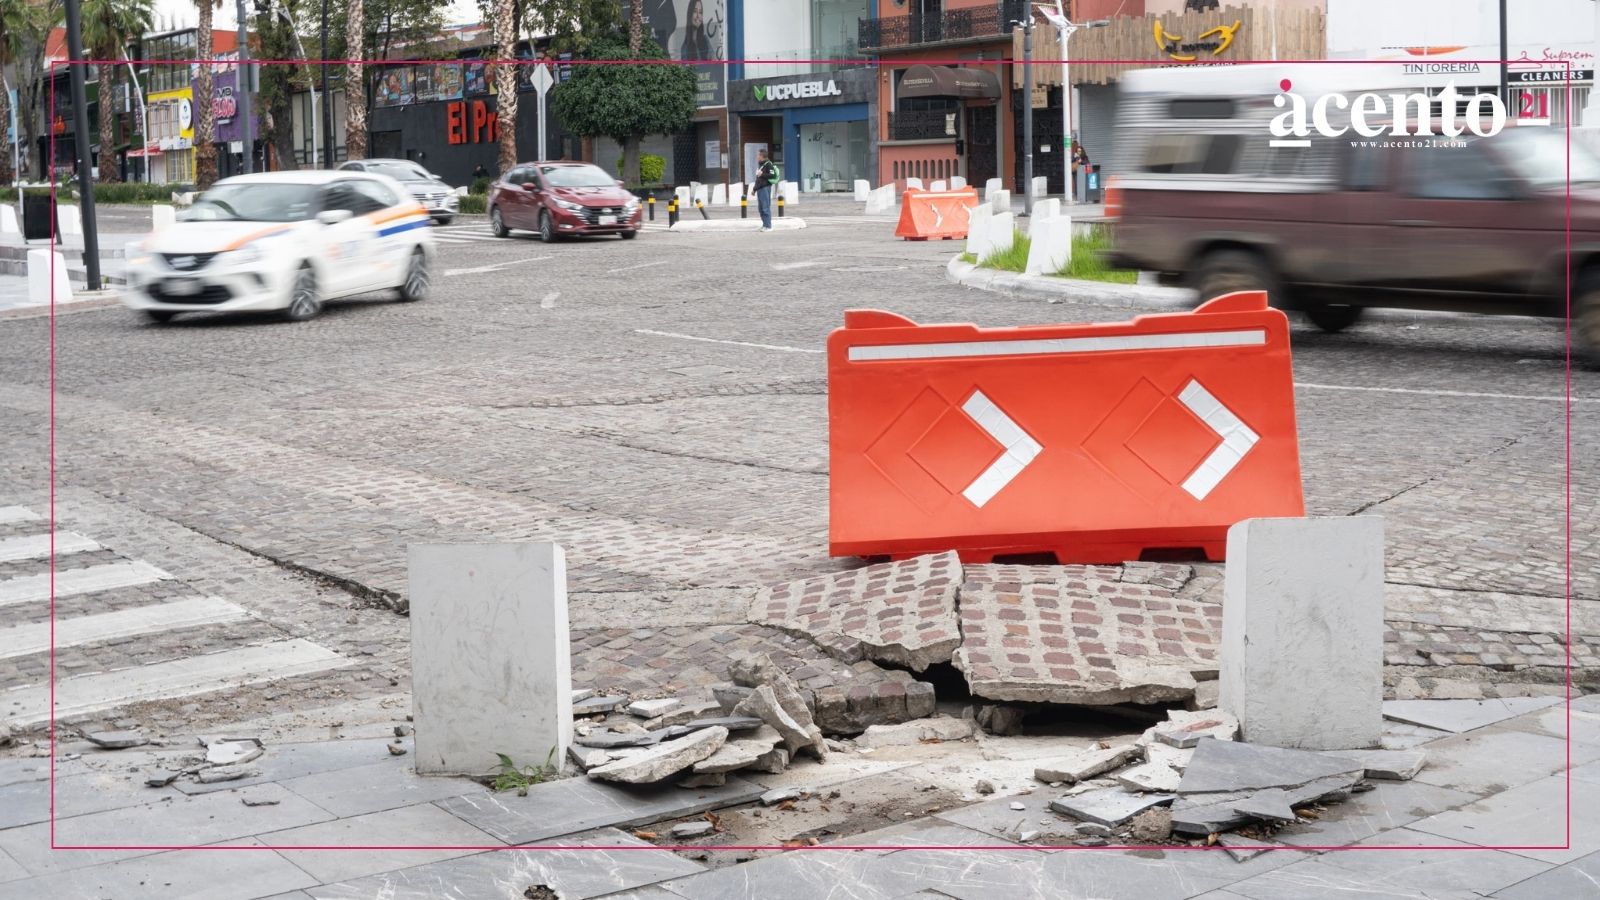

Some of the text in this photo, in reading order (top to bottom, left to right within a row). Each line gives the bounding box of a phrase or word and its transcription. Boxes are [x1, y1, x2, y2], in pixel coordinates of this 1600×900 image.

[1521, 71, 1584, 81] CLEANERS
[447, 100, 500, 145] El Pr
